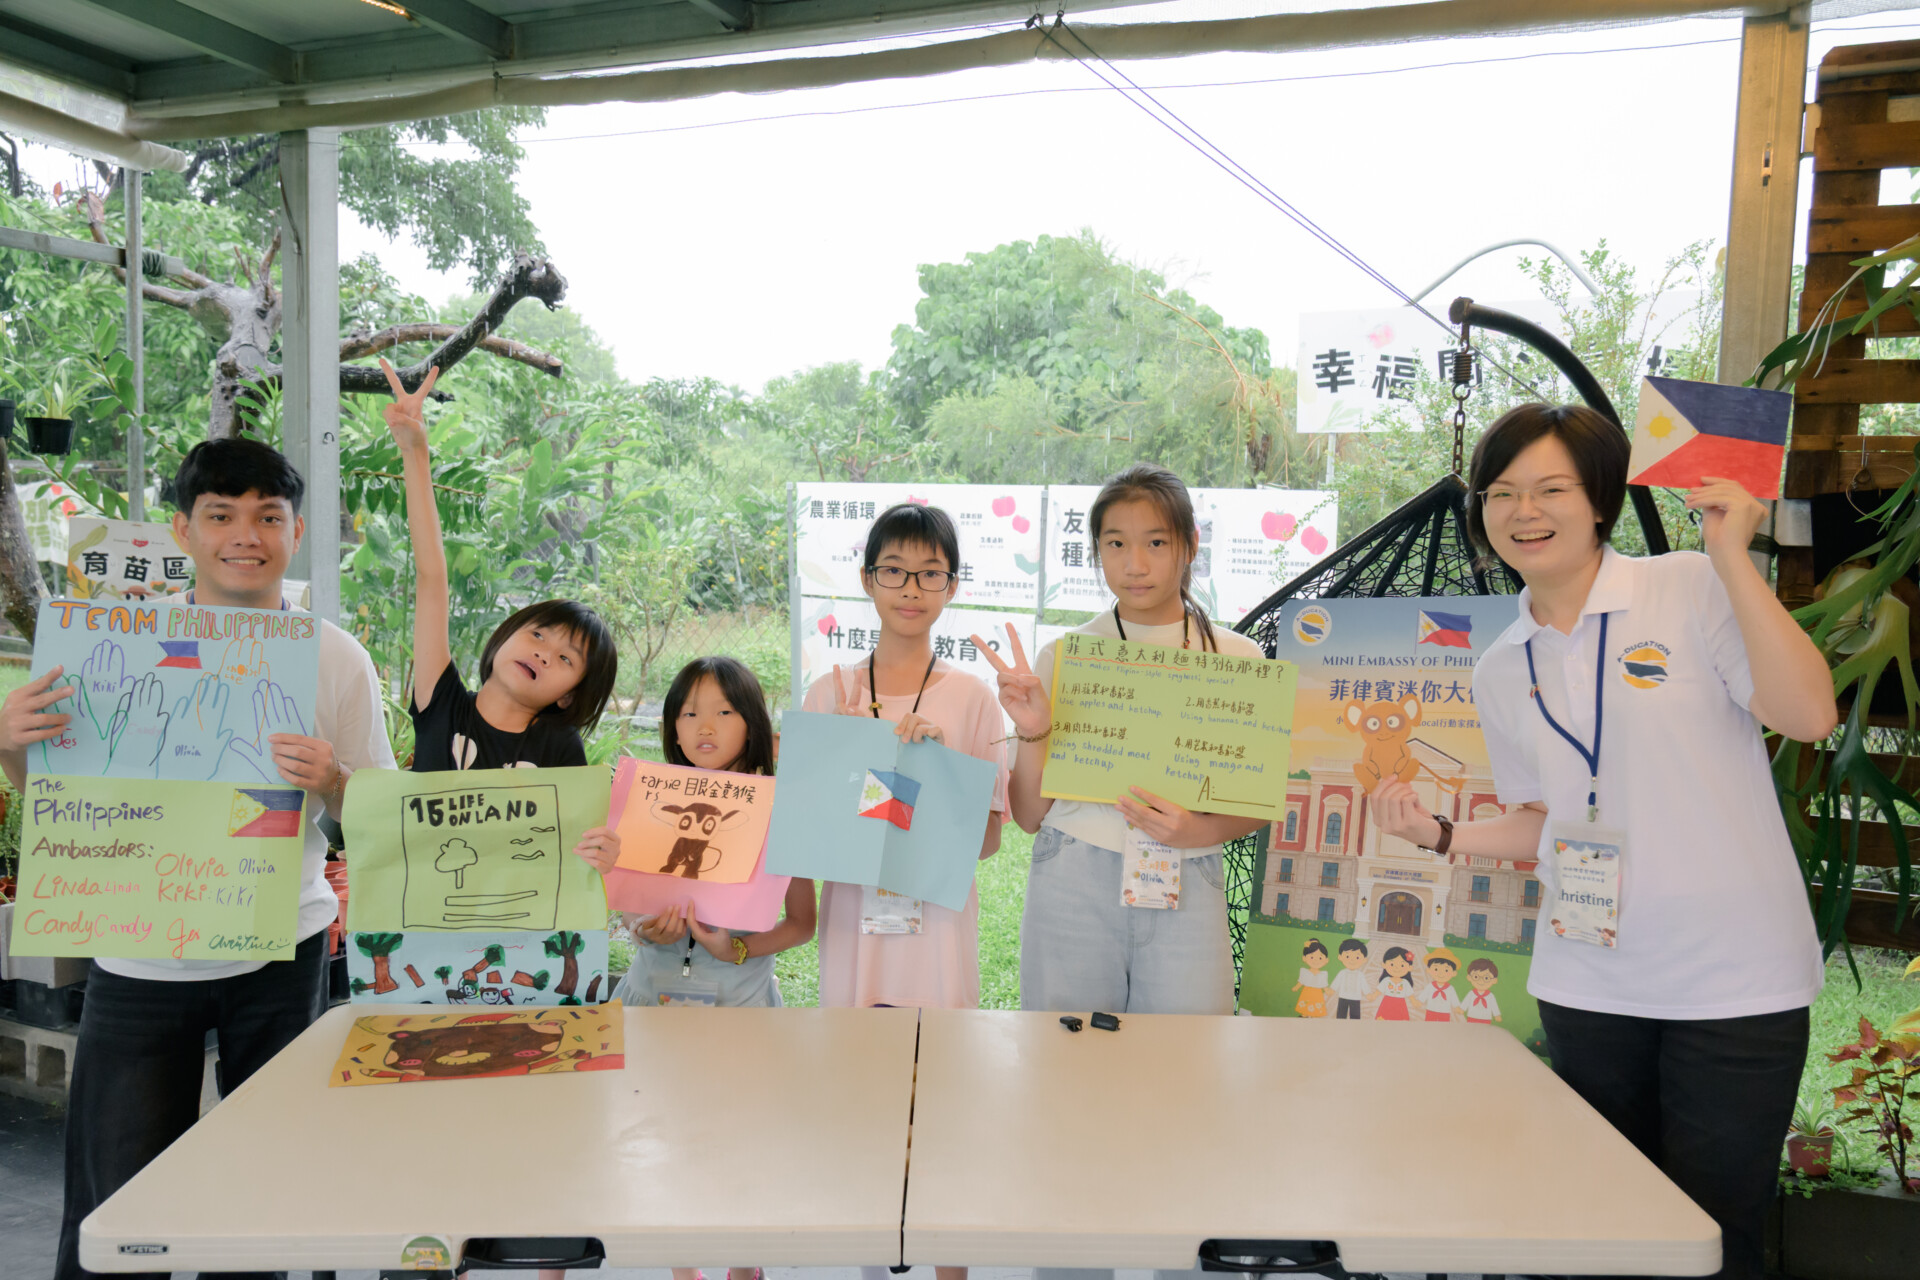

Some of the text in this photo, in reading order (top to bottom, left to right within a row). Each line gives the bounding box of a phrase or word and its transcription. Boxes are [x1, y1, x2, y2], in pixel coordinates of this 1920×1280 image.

[810, 500, 875, 519] 農業循環
[82, 551, 190, 582] 育苗區
[49, 601, 314, 640] TEAM PHILIPPINES
[1322, 655, 1481, 667] MINI EMBASSY OF PHIL
[1617, 640, 1671, 663] A-DUCATION
[1329, 679, 1476, 704] 菲律賓迷你大
[1059, 697, 1075, 706] Use
[1079, 699, 1106, 709] apples
[1108, 702, 1124, 711] and
[1180, 711, 1204, 725] Using
[1208, 714, 1239, 725] bananas
[1243, 719, 1258, 728] and
[1052, 738, 1151, 761] Using shredded meat
[1050, 752, 1115, 773] and ketchup
[1174, 753, 1264, 774] Using mango and
[641, 775, 681, 791] tarsie
[1166, 765, 1205, 785] ketchup
[31, 778, 66, 794] The
[409, 797, 444, 827] 15
[449, 793, 485, 811] LIFE
[476, 800, 537, 825] LAND
[155, 852, 276, 880] Olivia Olivia
[104, 881, 141, 896] Linda
[1559, 888, 1613, 907] hristine
[24, 909, 94, 946] Candy
[94, 914, 153, 943] Candy
